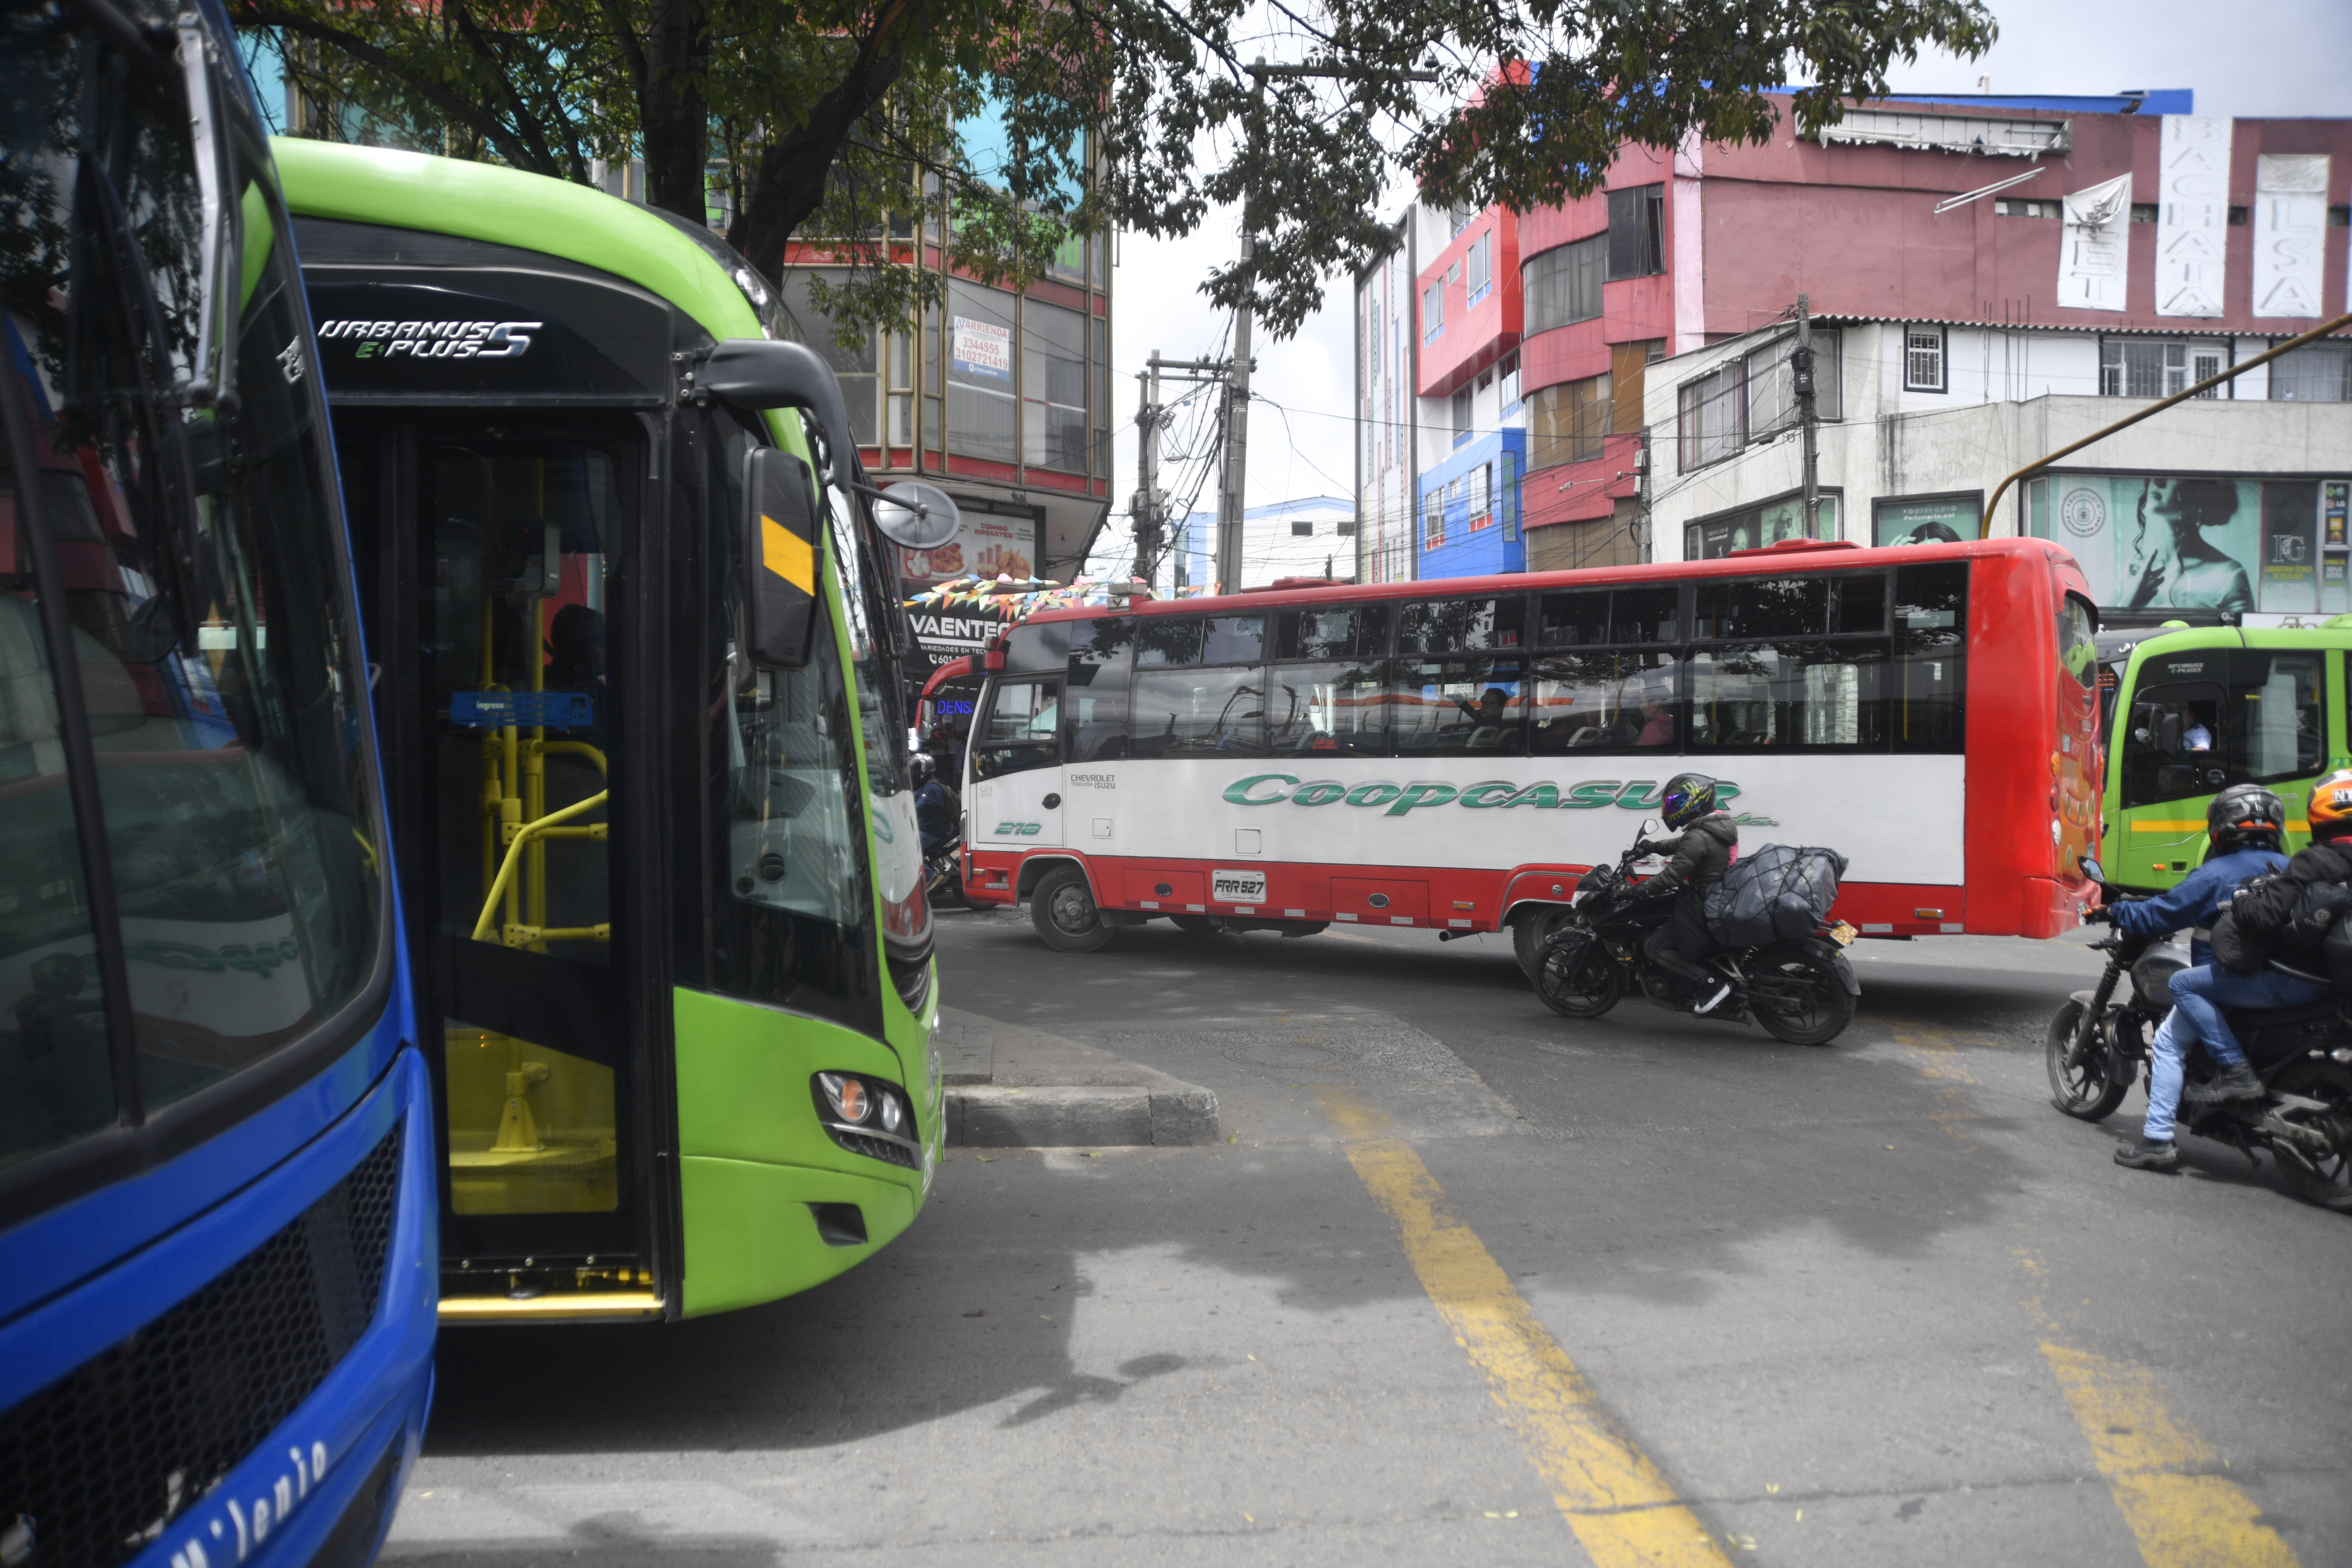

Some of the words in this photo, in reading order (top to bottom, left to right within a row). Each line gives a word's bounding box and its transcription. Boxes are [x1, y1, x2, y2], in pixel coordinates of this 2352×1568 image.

[2163, 118, 2223, 310] BACHATA
[965, 320, 1007, 338] ARRIENDA
[963, 337, 999, 355] 3344555
[956, 347, 1008, 369] 3102721419
[975, 529, 1013, 539] BROASTED
[980, 523, 1007, 531] COMBO
[920, 644, 958, 653] VARIEDADES
[476, 701, 504, 710] ingreso
[994, 821, 1042, 835] 218
